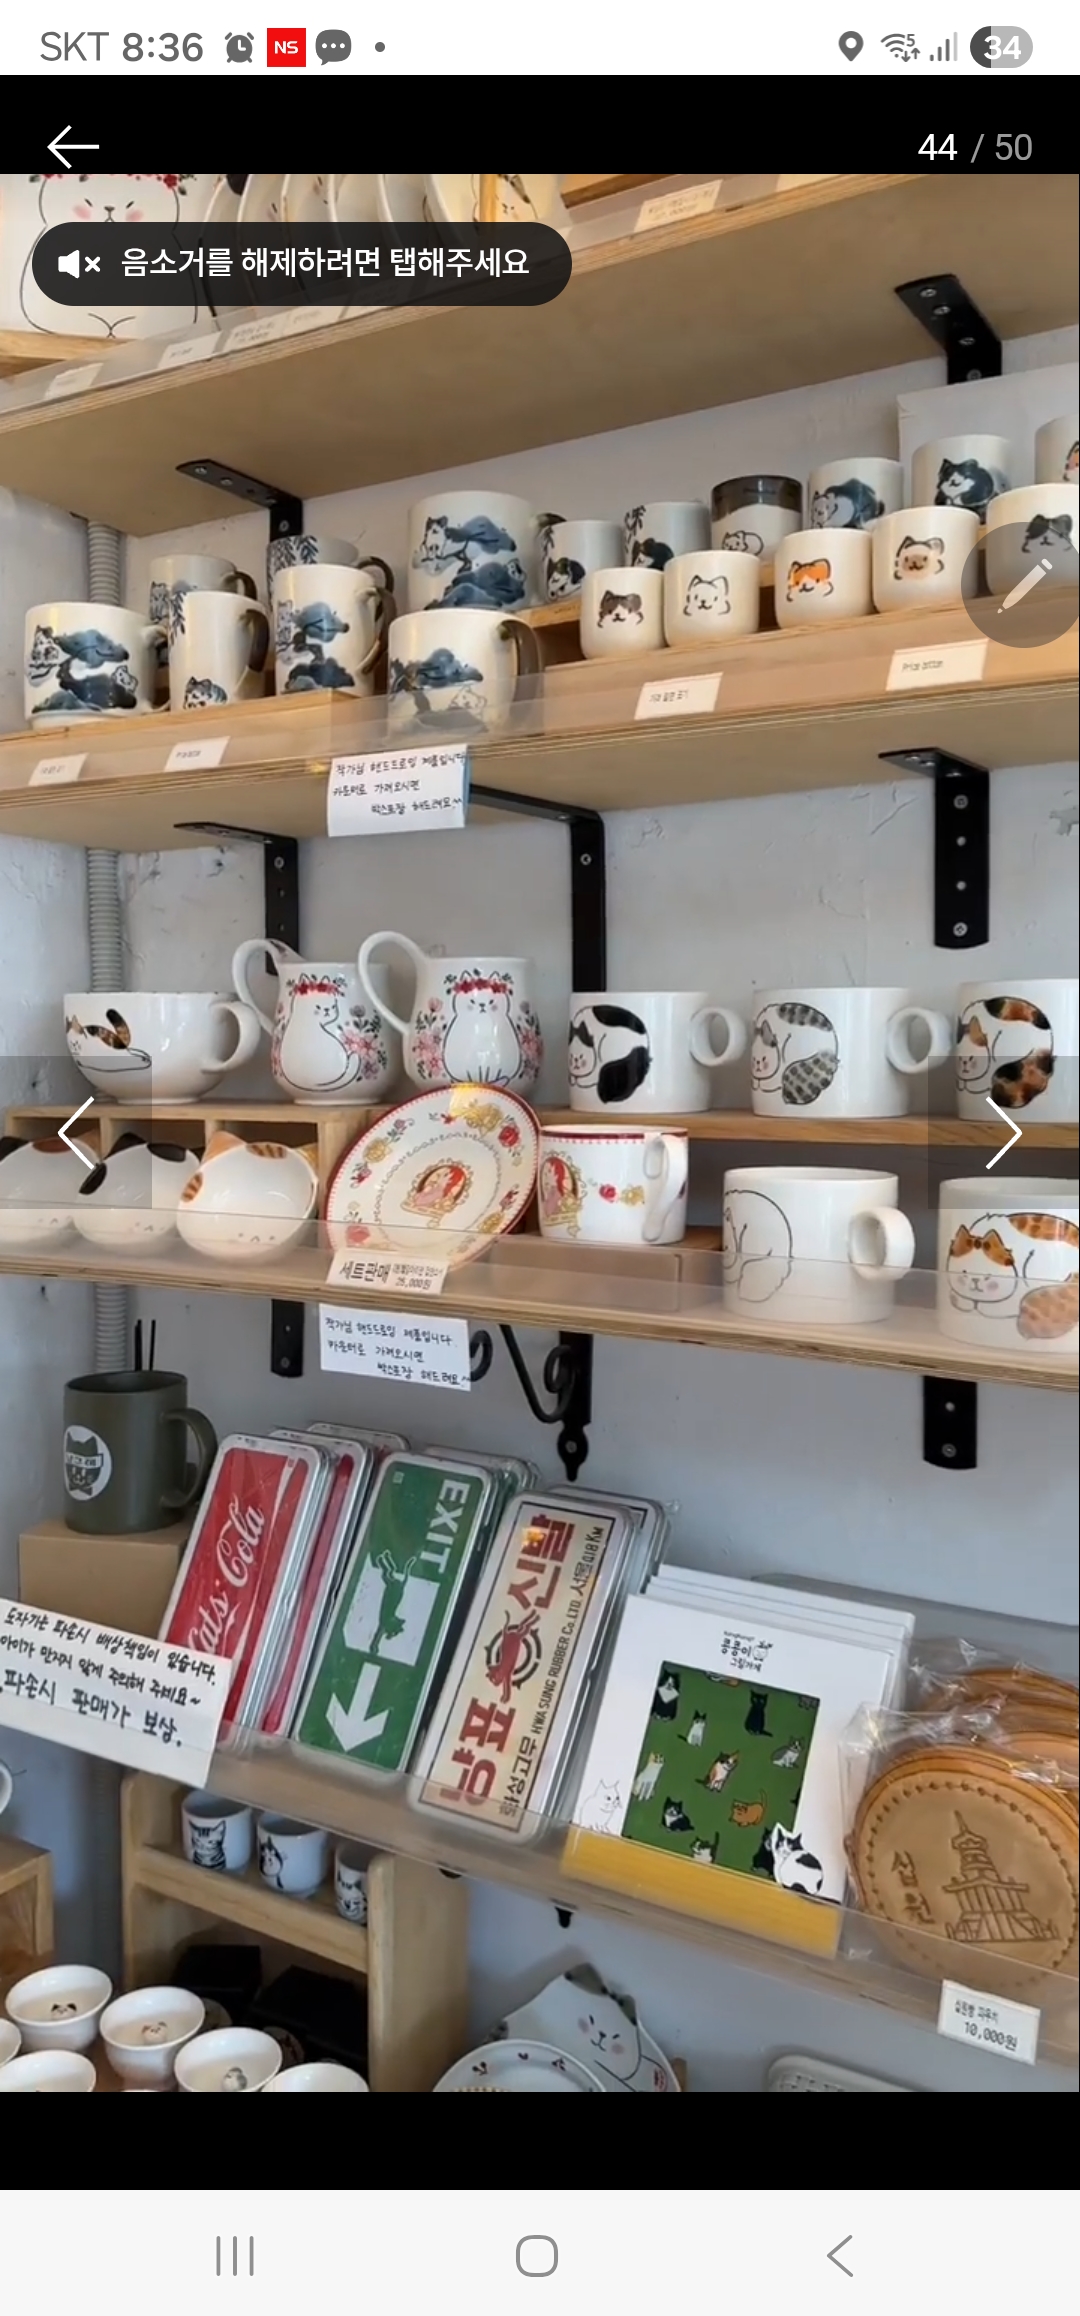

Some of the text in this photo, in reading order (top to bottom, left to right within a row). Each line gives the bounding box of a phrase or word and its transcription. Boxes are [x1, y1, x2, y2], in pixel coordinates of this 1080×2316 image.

[339, 1260, 392, 1284] 세트판매
[395, 1276, 432, 1291] 25,000원
[325, 1317, 353, 1335] 작가님
[356, 1322, 397, 1339] 핸드드로잉
[327, 1339, 367, 1357] 카운터로
[377, 1362, 414, 1380] 박스포장
[216, 1492, 266, 1588] Cola
[419, 1479, 471, 1574] EXIT
[507, 1514, 576, 1610] 신발
[4, 1606, 49, 1631] 도자기는
[52, 1619, 92, 1645] 파손시
[96, 1632, 161, 1664] 배상책임이
[0, 1634, 36, 1659] 아이가
[108, 1666, 146, 1694] 주의해
[548, 1636, 571, 1678] RUBBER
[3, 1667, 182, 1748] 파손시 판매가 보상.
[538, 1678, 557, 1710] SUNG
[530, 1708, 548, 1735] HWA
[499, 1735, 538, 1818] 화성고무
[964, 2020, 1019, 2053] 10,000원
